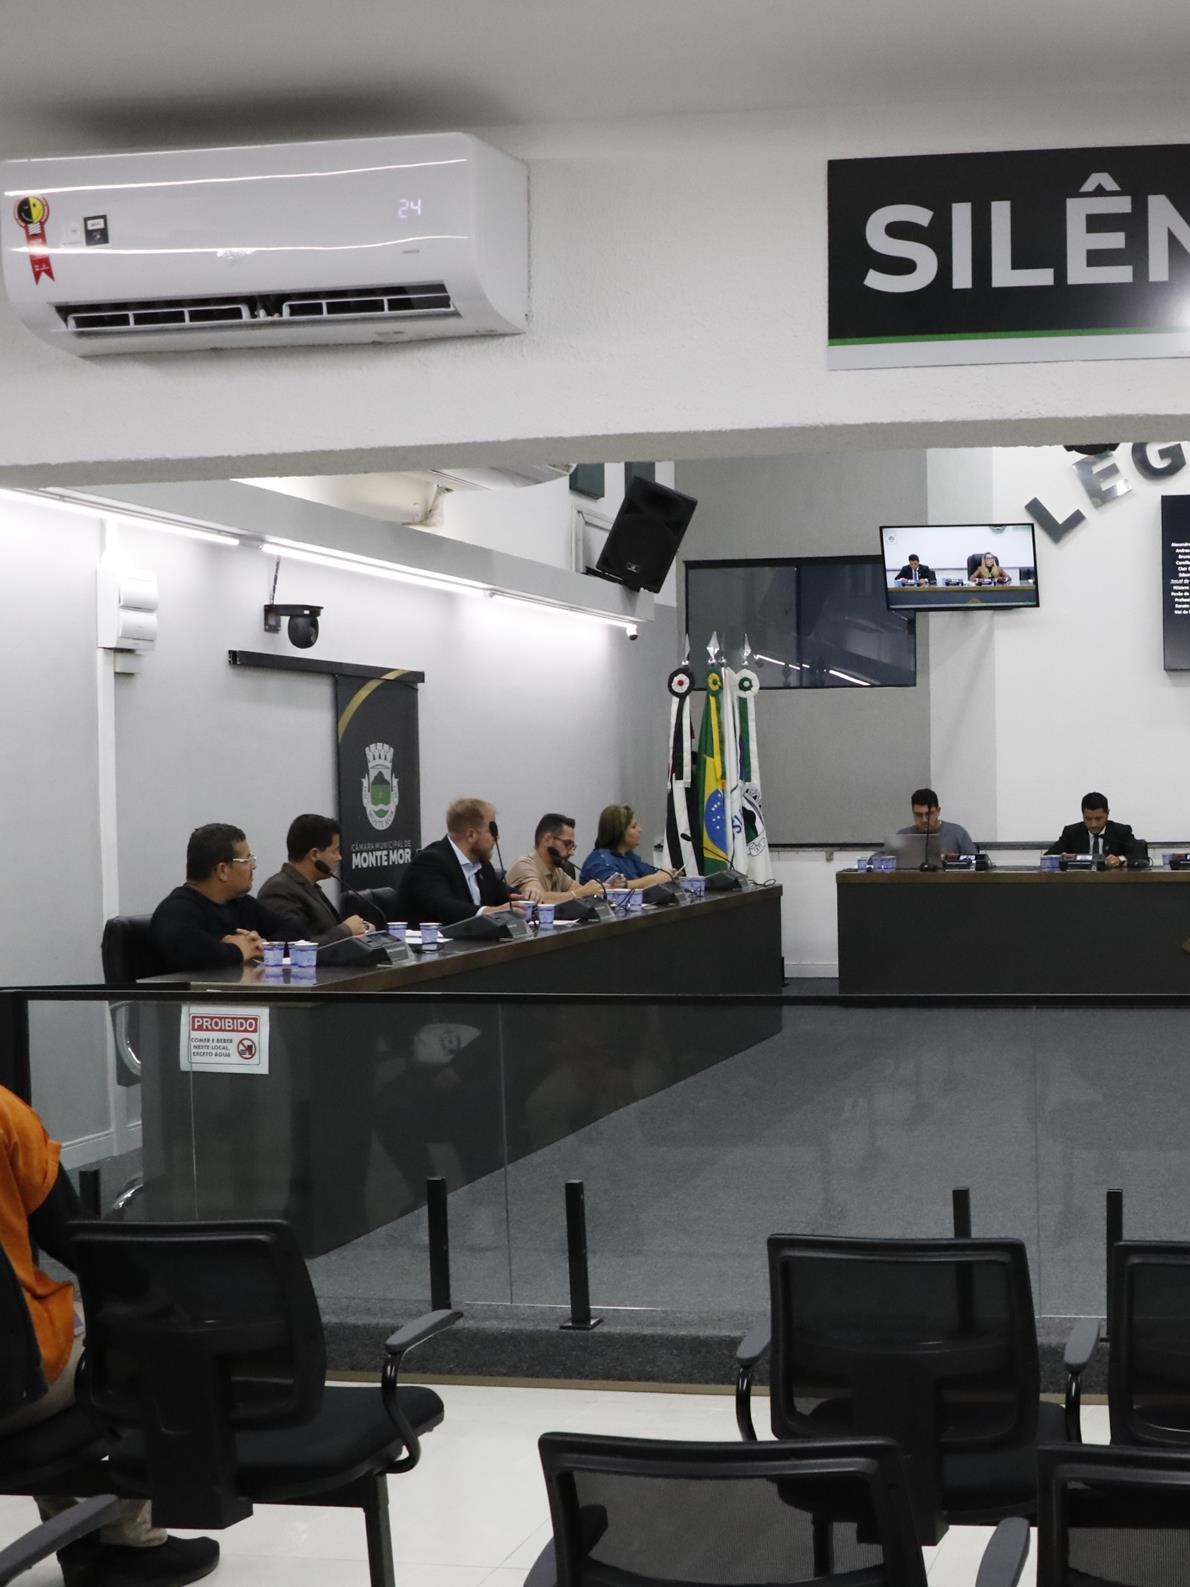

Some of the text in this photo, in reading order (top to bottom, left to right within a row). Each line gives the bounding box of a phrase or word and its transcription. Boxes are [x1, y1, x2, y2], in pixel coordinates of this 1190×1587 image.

[398, 198, 421, 218] 24
[352, 848, 411, 869] MONTE MOR
[194, 1017, 256, 1031] PROIBIDO
